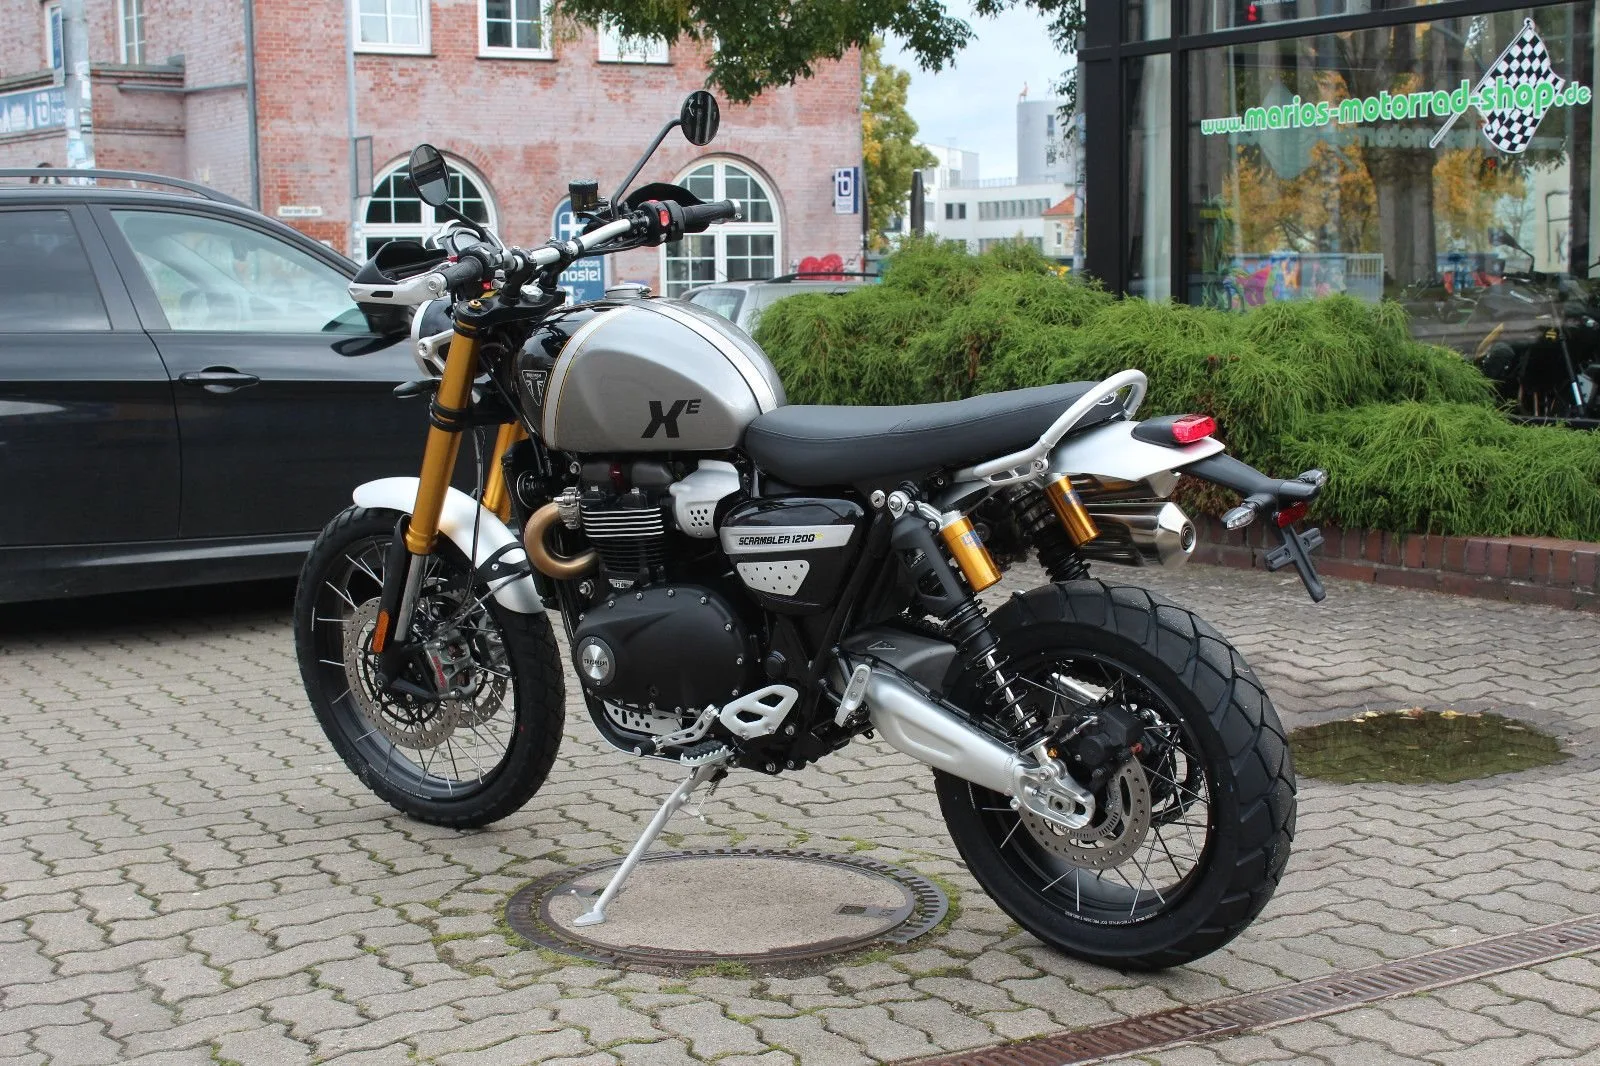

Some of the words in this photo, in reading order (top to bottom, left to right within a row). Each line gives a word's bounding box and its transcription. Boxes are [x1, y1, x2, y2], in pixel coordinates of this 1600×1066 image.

[1201, 75, 1592, 135] www.marios-motorrad-shop.de
[739, 536, 790, 545] SCRAMBLER
[792, 534, 815, 543] 1200
